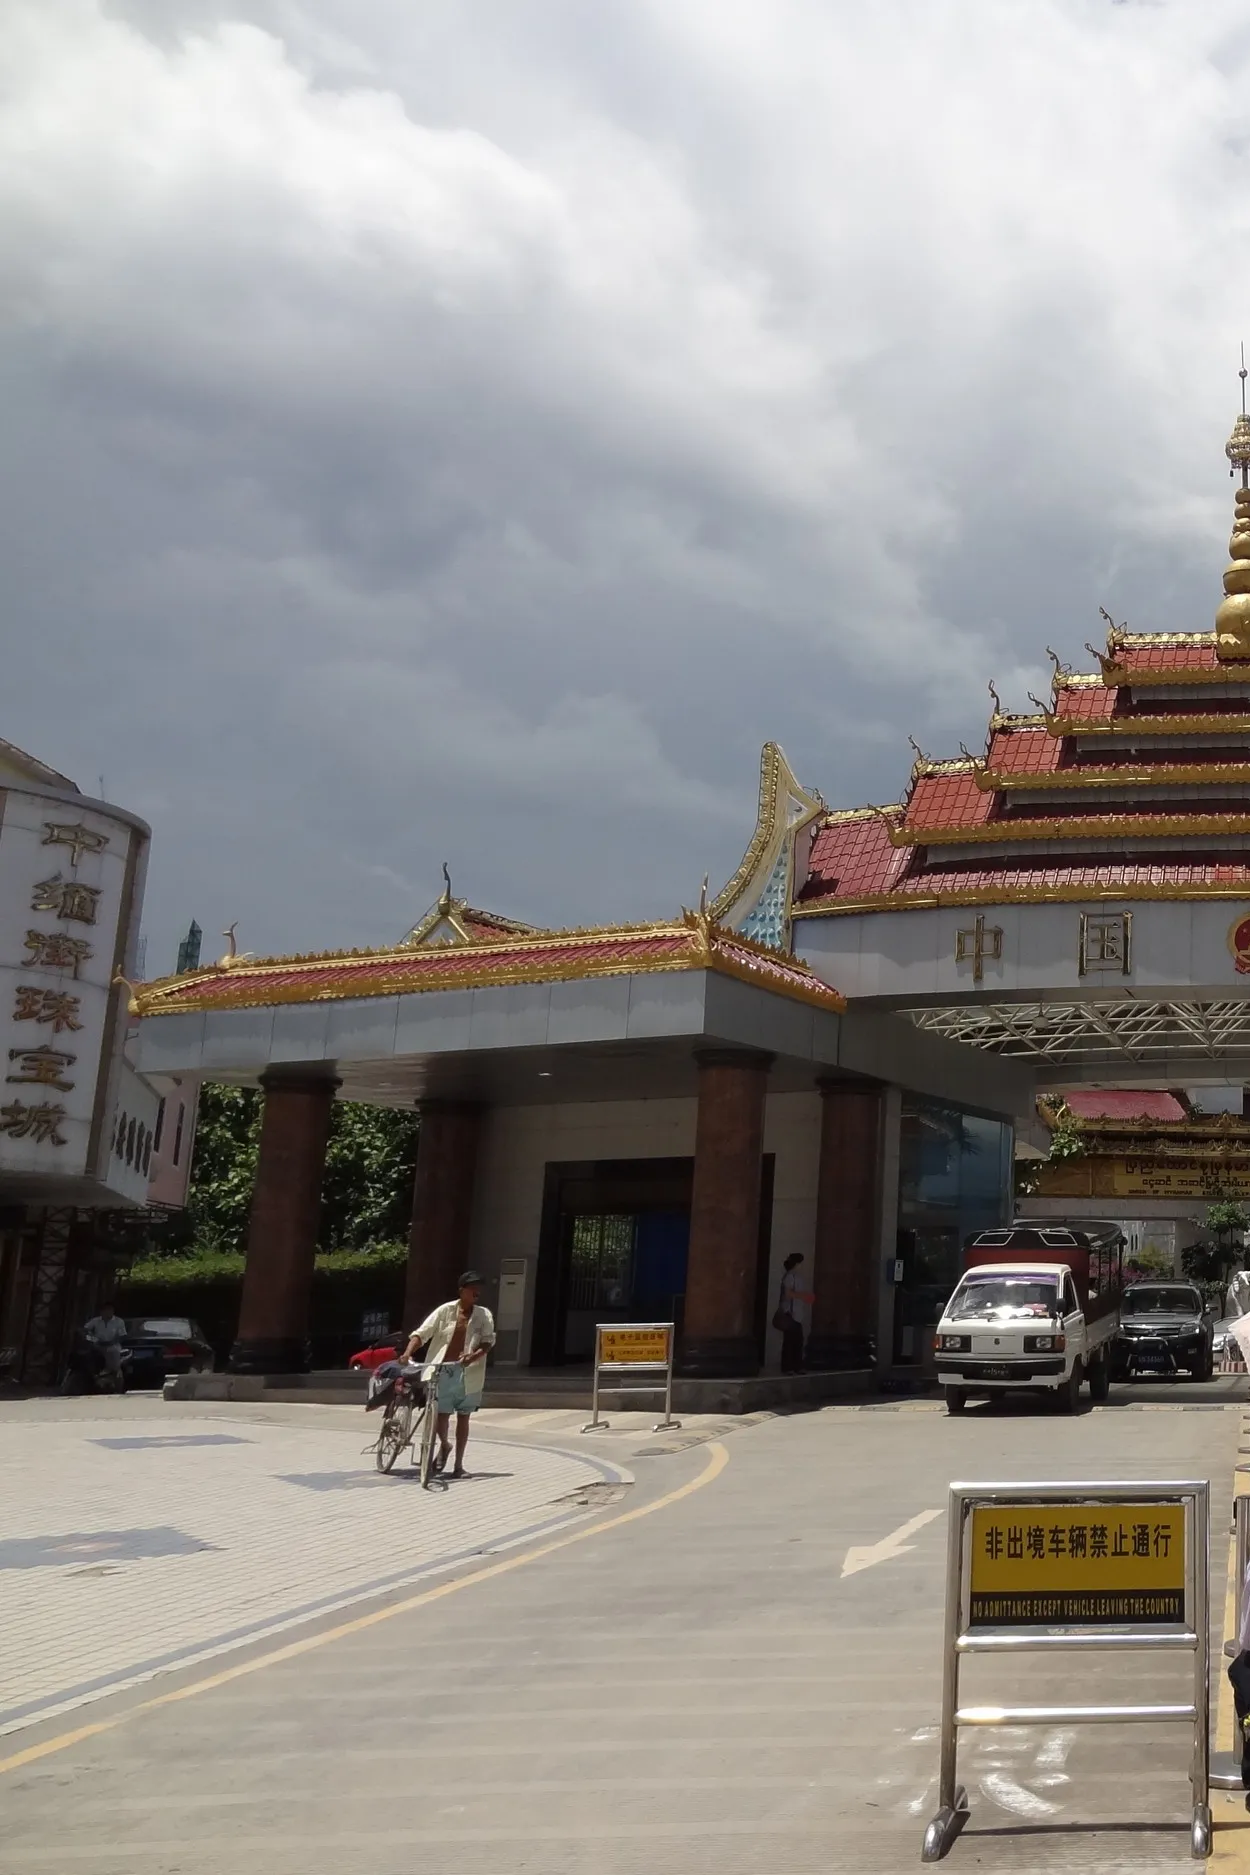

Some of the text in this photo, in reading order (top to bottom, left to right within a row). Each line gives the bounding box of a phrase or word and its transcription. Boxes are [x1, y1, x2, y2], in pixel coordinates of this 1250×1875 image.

[955, 911, 1133, 982] 中国
[985, 1523, 1172, 1560] 非出境车辆禁止通行
[973, 1597, 1180, 1617] NO ADMITTANCE EXCEPT VEHICLE LEAVING THE COUNTRY
